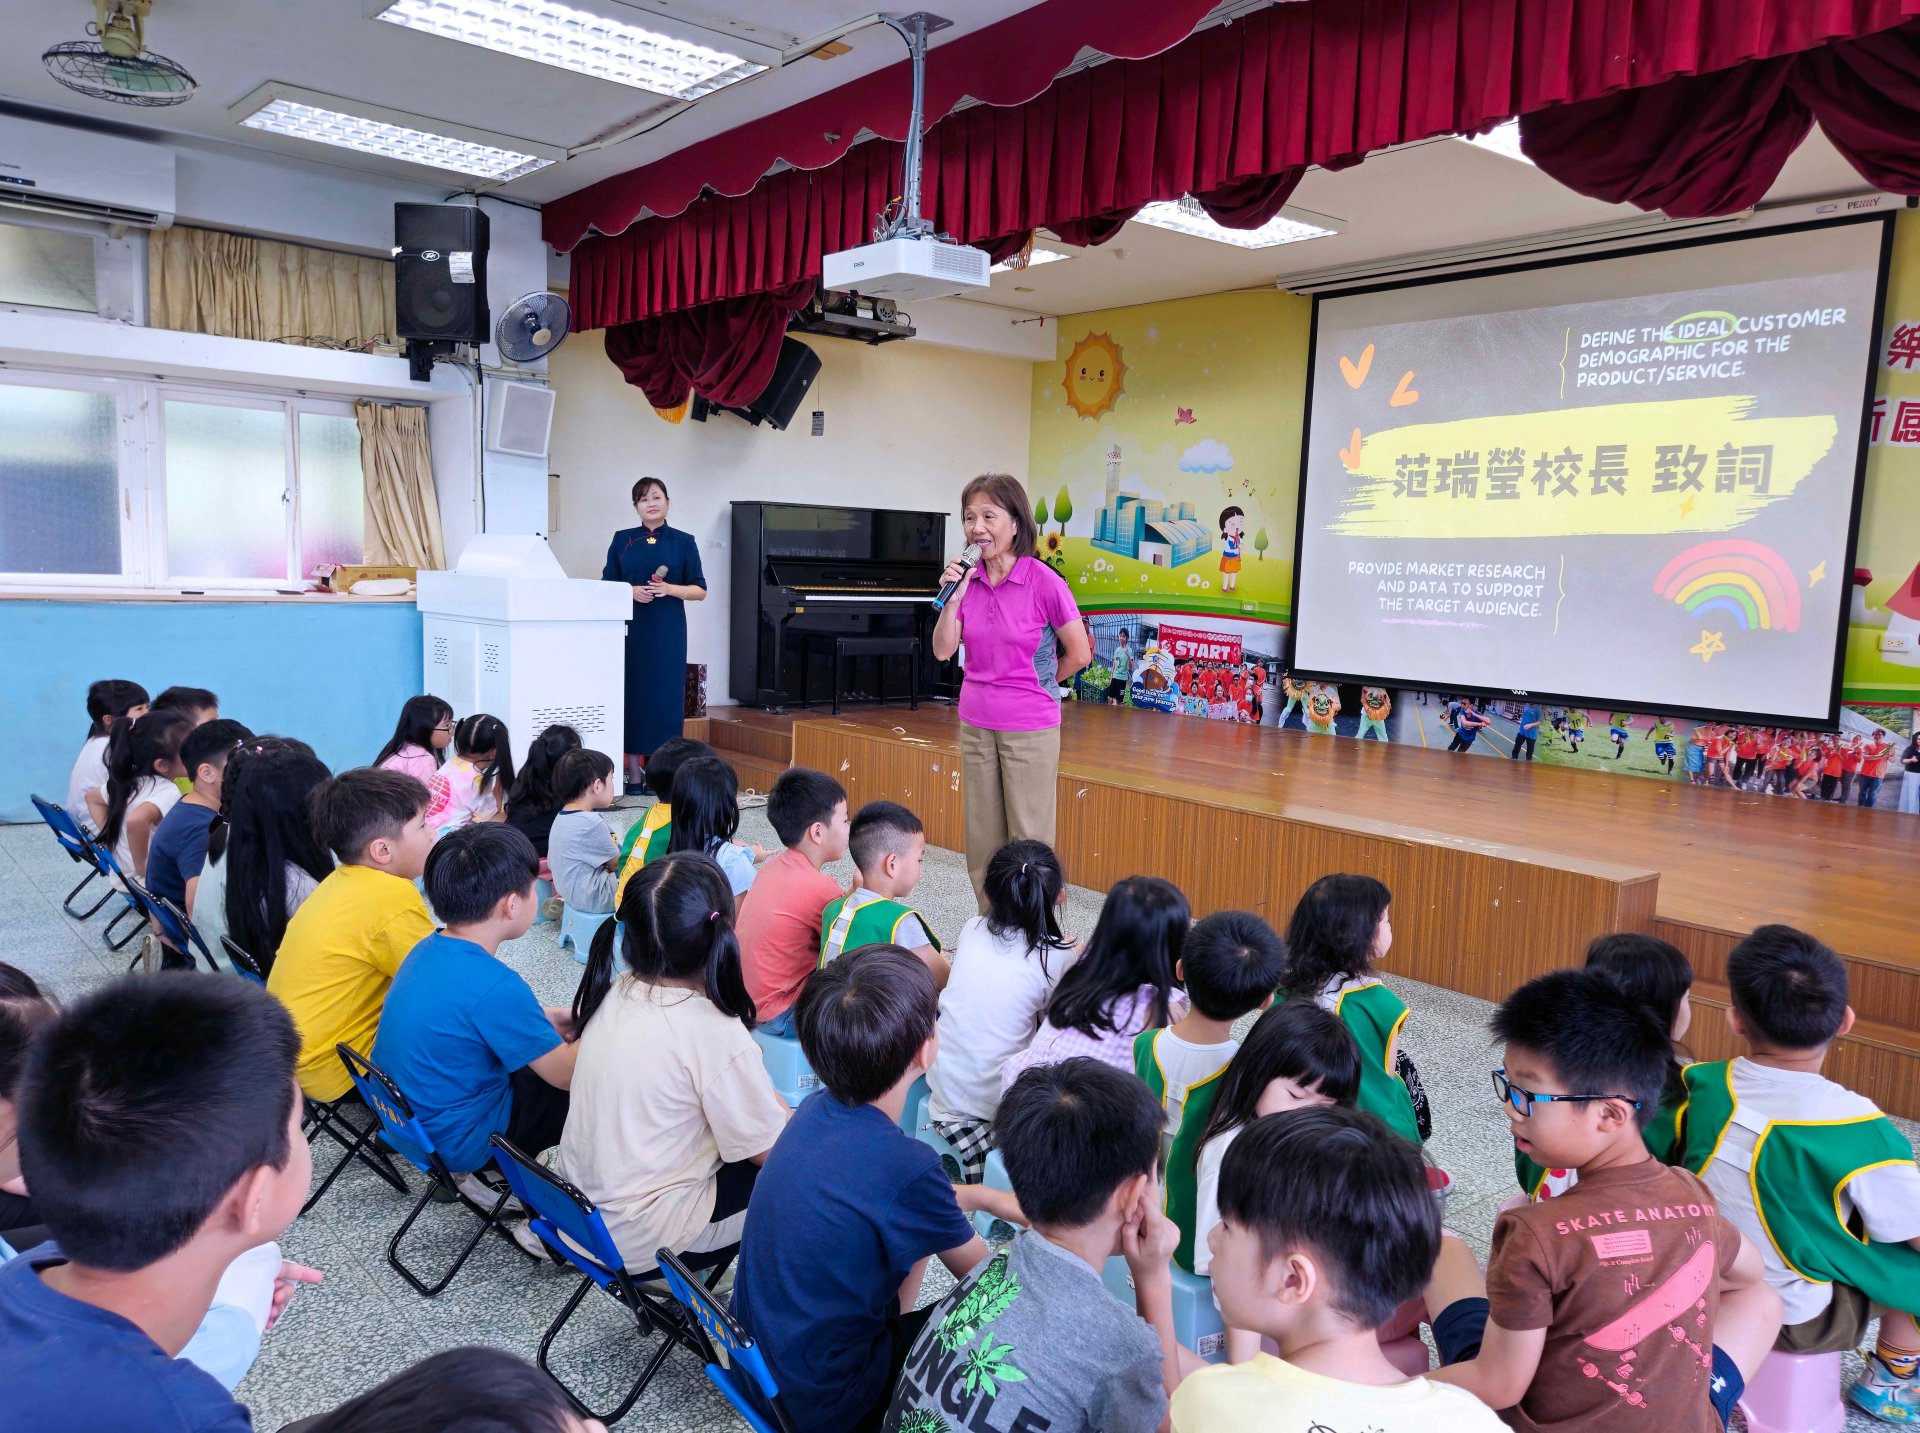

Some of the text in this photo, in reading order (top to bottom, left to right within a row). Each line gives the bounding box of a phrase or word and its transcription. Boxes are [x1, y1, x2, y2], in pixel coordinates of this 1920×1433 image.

[1581, 308, 1847, 348] DEFINE THE IDEAL CUSTOMER
[1579, 335, 1791, 368] DEMOGRAPHIC FOR THE
[1577, 360, 1746, 387] PRODUCT/SERVICE.
[1392, 442, 1774, 500] 范瑞瑩校長 致詞
[1349, 561, 1546, 580] PROVIDE MARKET RESEARCH
[1377, 580, 1544, 598] AND DATA TO SUPPORT
[1379, 597, 1542, 617] THE TARGET AUDIENCE.
[1175, 640, 1231, 661] START
[1572, 719, 1581, 728] 10
[1556, 1210, 1628, 1235] SKATE
